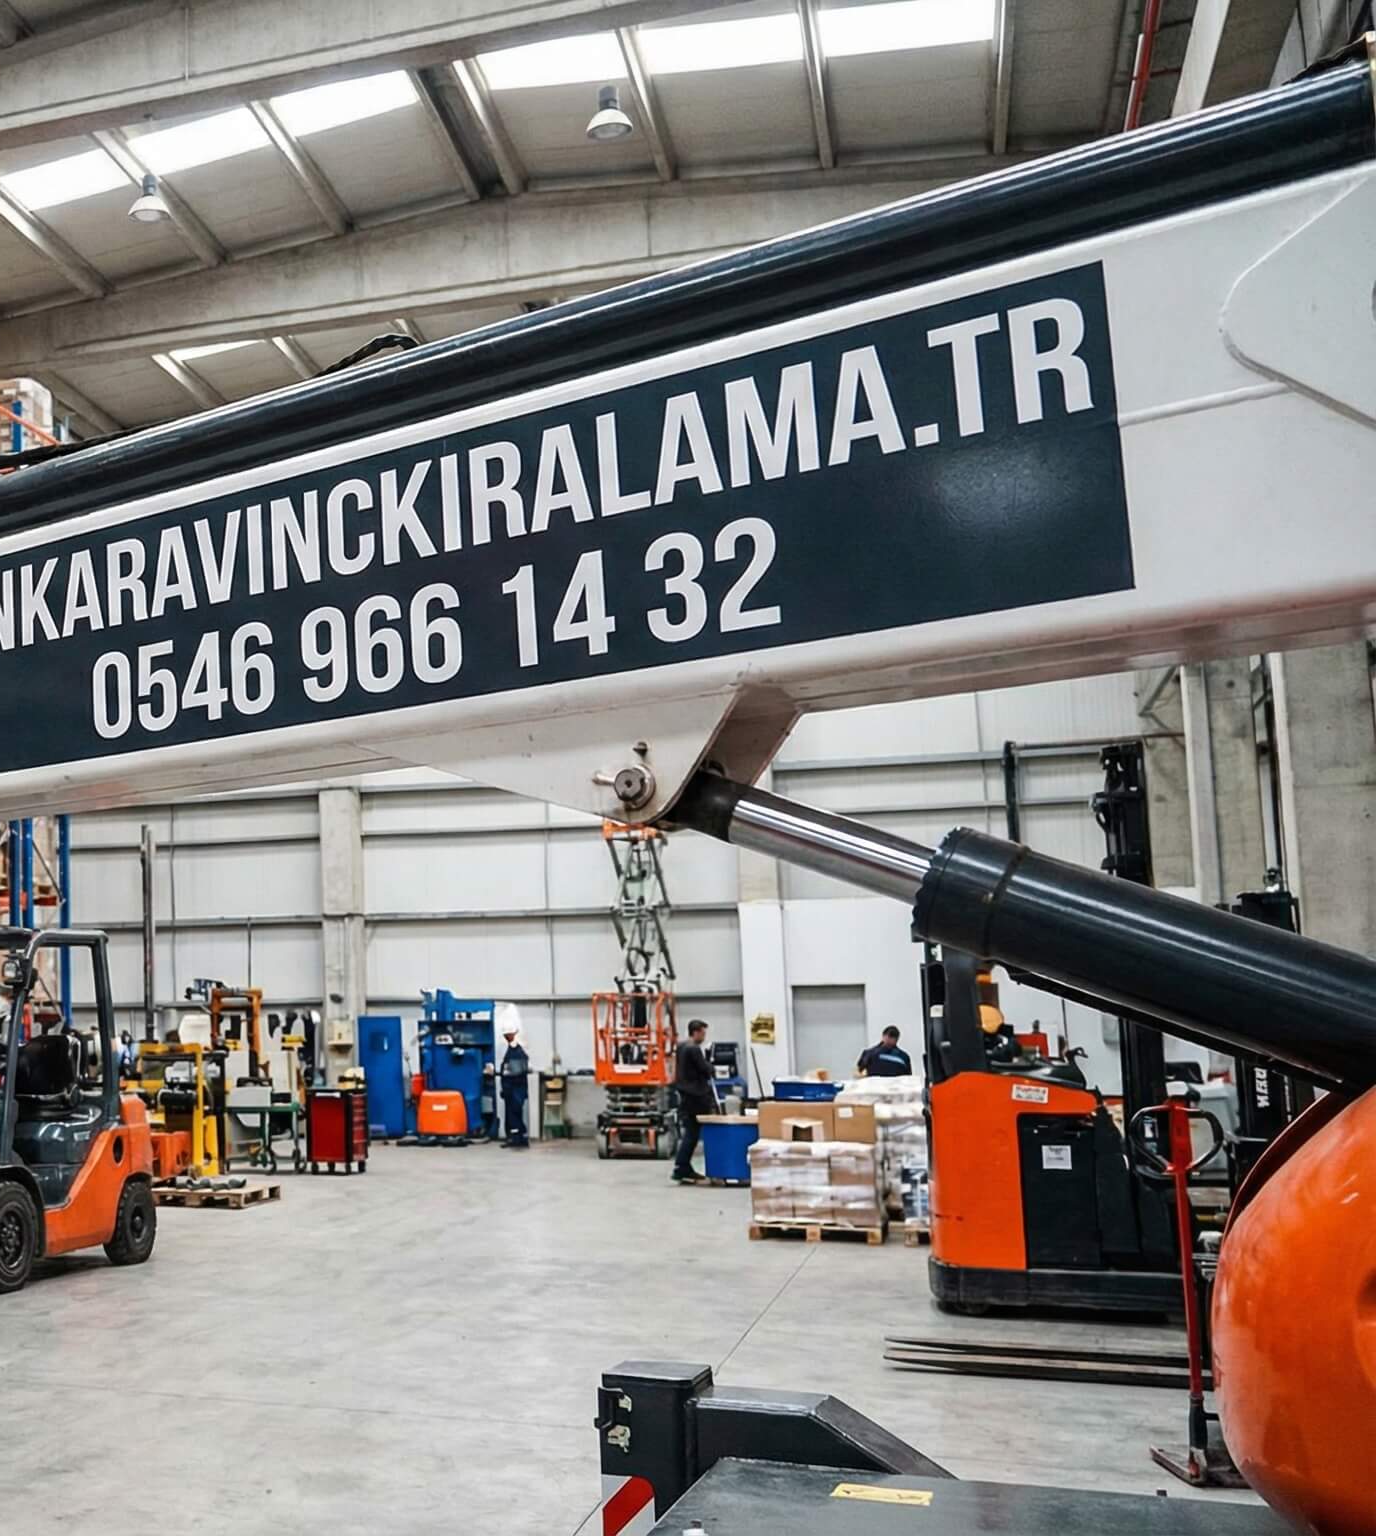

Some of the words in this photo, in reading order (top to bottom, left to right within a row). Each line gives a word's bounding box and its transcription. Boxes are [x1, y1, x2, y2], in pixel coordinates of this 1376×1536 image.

[92, 621, 275, 739] 0546
[300, 582, 463, 703] 966
[502, 549, 616, 668] 14
[644, 517, 781, 642] 32
